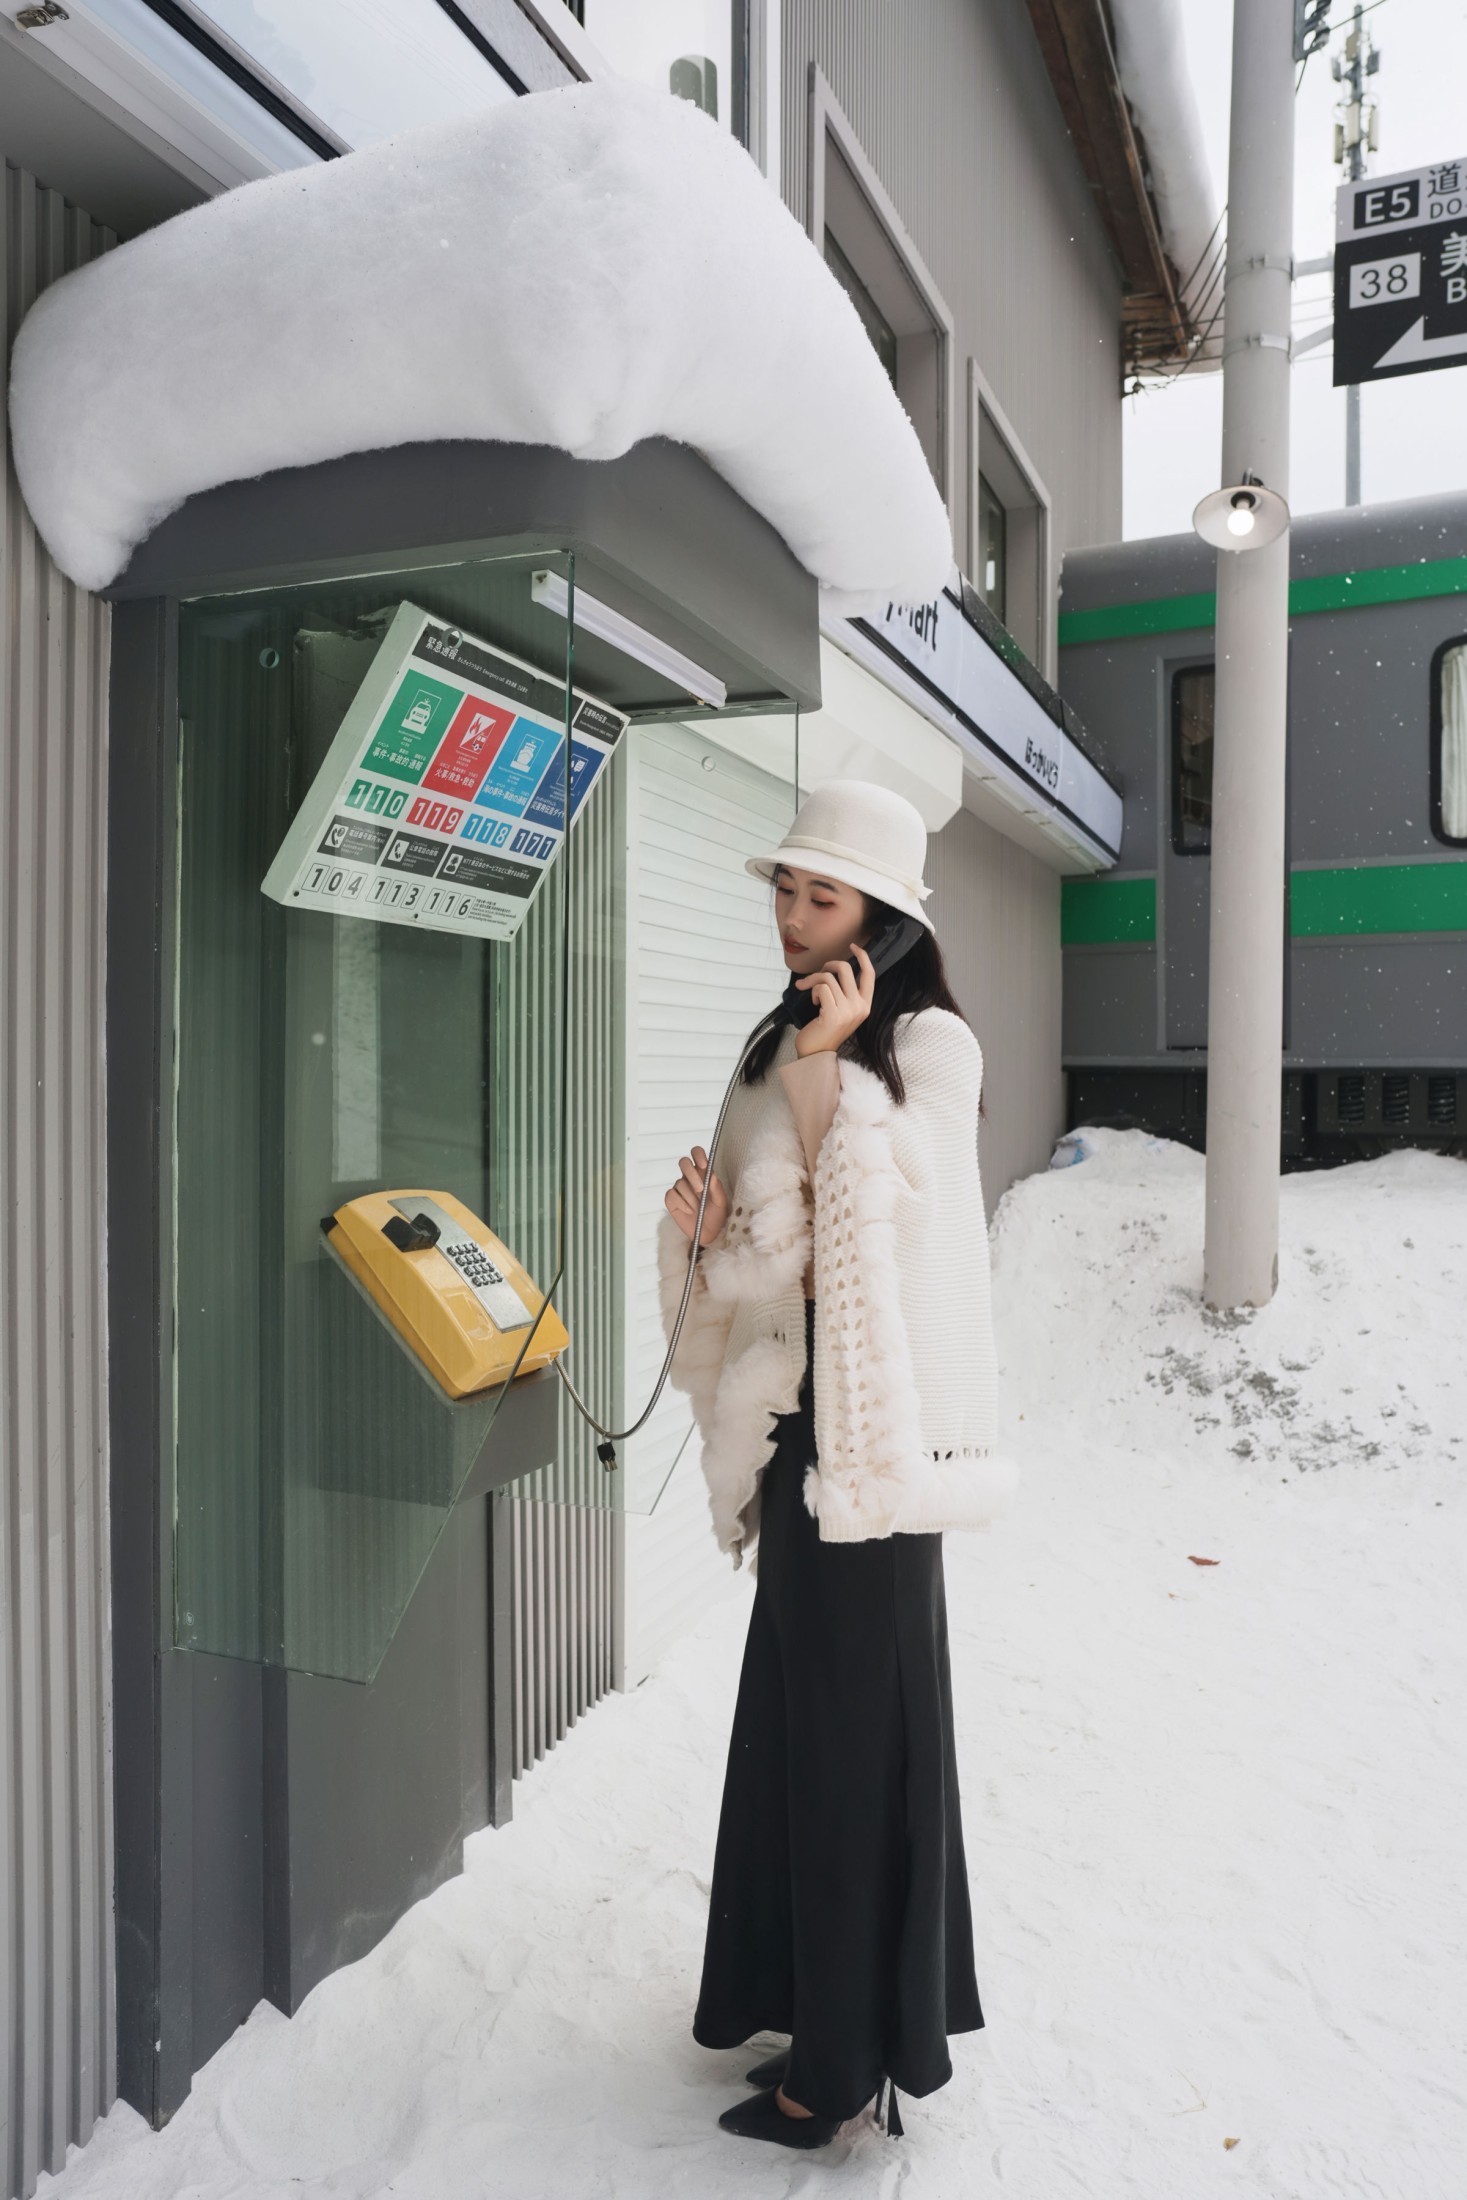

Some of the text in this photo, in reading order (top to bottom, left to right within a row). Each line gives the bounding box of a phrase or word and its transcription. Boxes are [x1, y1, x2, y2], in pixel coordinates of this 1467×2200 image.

[1428, 163, 1467, 198] 道
[1365, 187, 1411, 224] E5
[1430, 198, 1467, 219] DO
[1361, 264, 1408, 299] 38
[1025, 736, 1058, 789] ほっかいどう
[351, 783, 404, 815] 110
[414, 802, 460, 830] 119
[467, 818, 509, 845] 118
[514, 831, 553, 858] 171
[311, 868, 363, 895] 104
[374, 881, 420, 906] 113
[429, 892, 471, 916] 116
